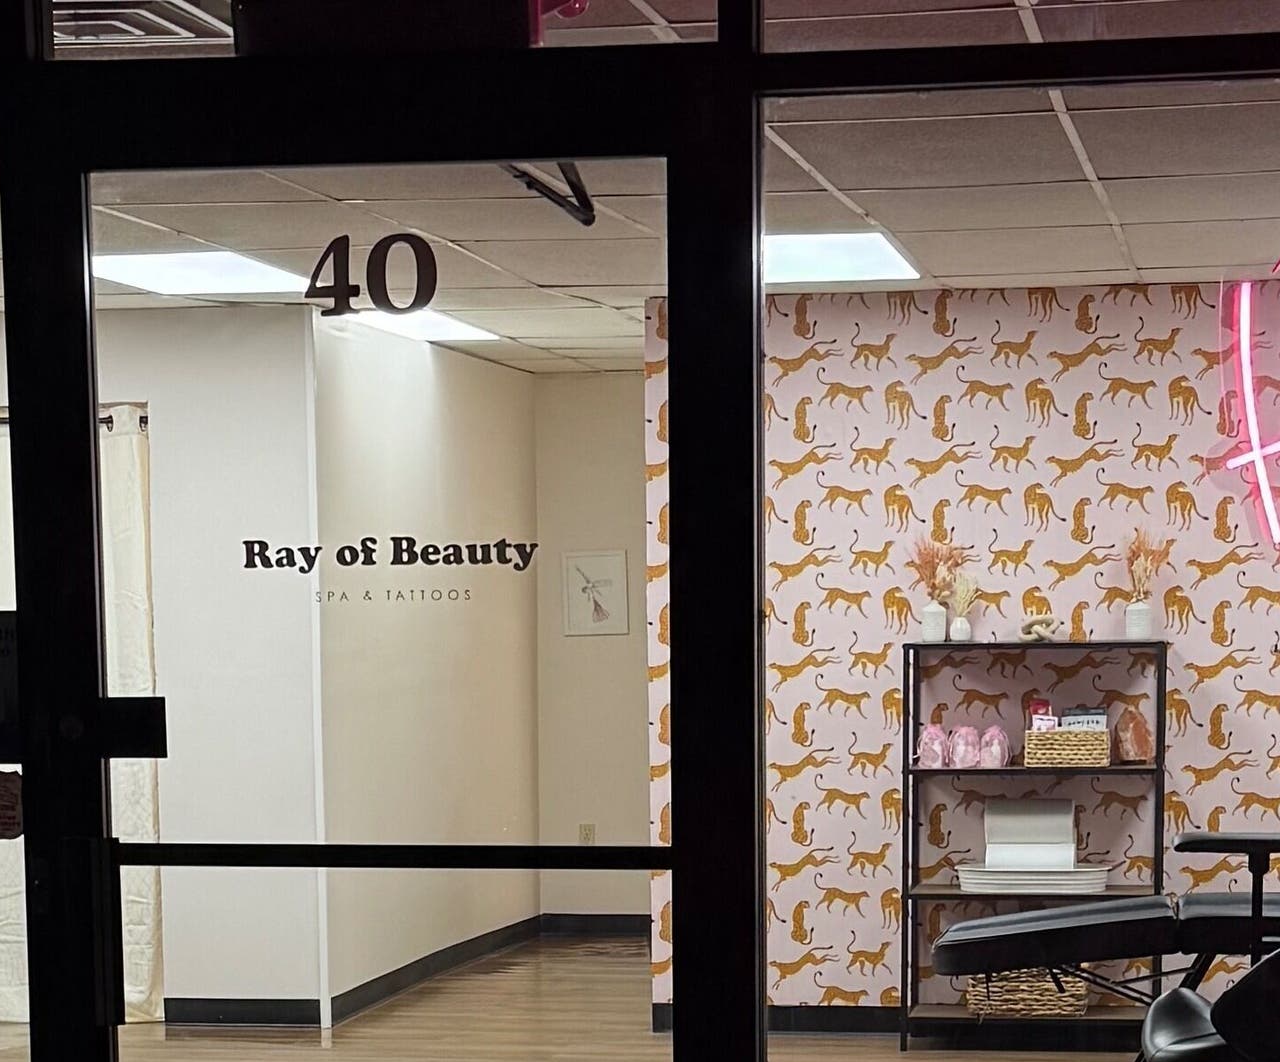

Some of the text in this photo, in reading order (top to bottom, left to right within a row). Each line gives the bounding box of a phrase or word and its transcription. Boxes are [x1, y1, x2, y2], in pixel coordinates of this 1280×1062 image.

[304, 233, 438, 316] 40
[243, 536, 539, 574] Ray of Beauty
[315, 589, 471, 603] SPA & TATTOOS
